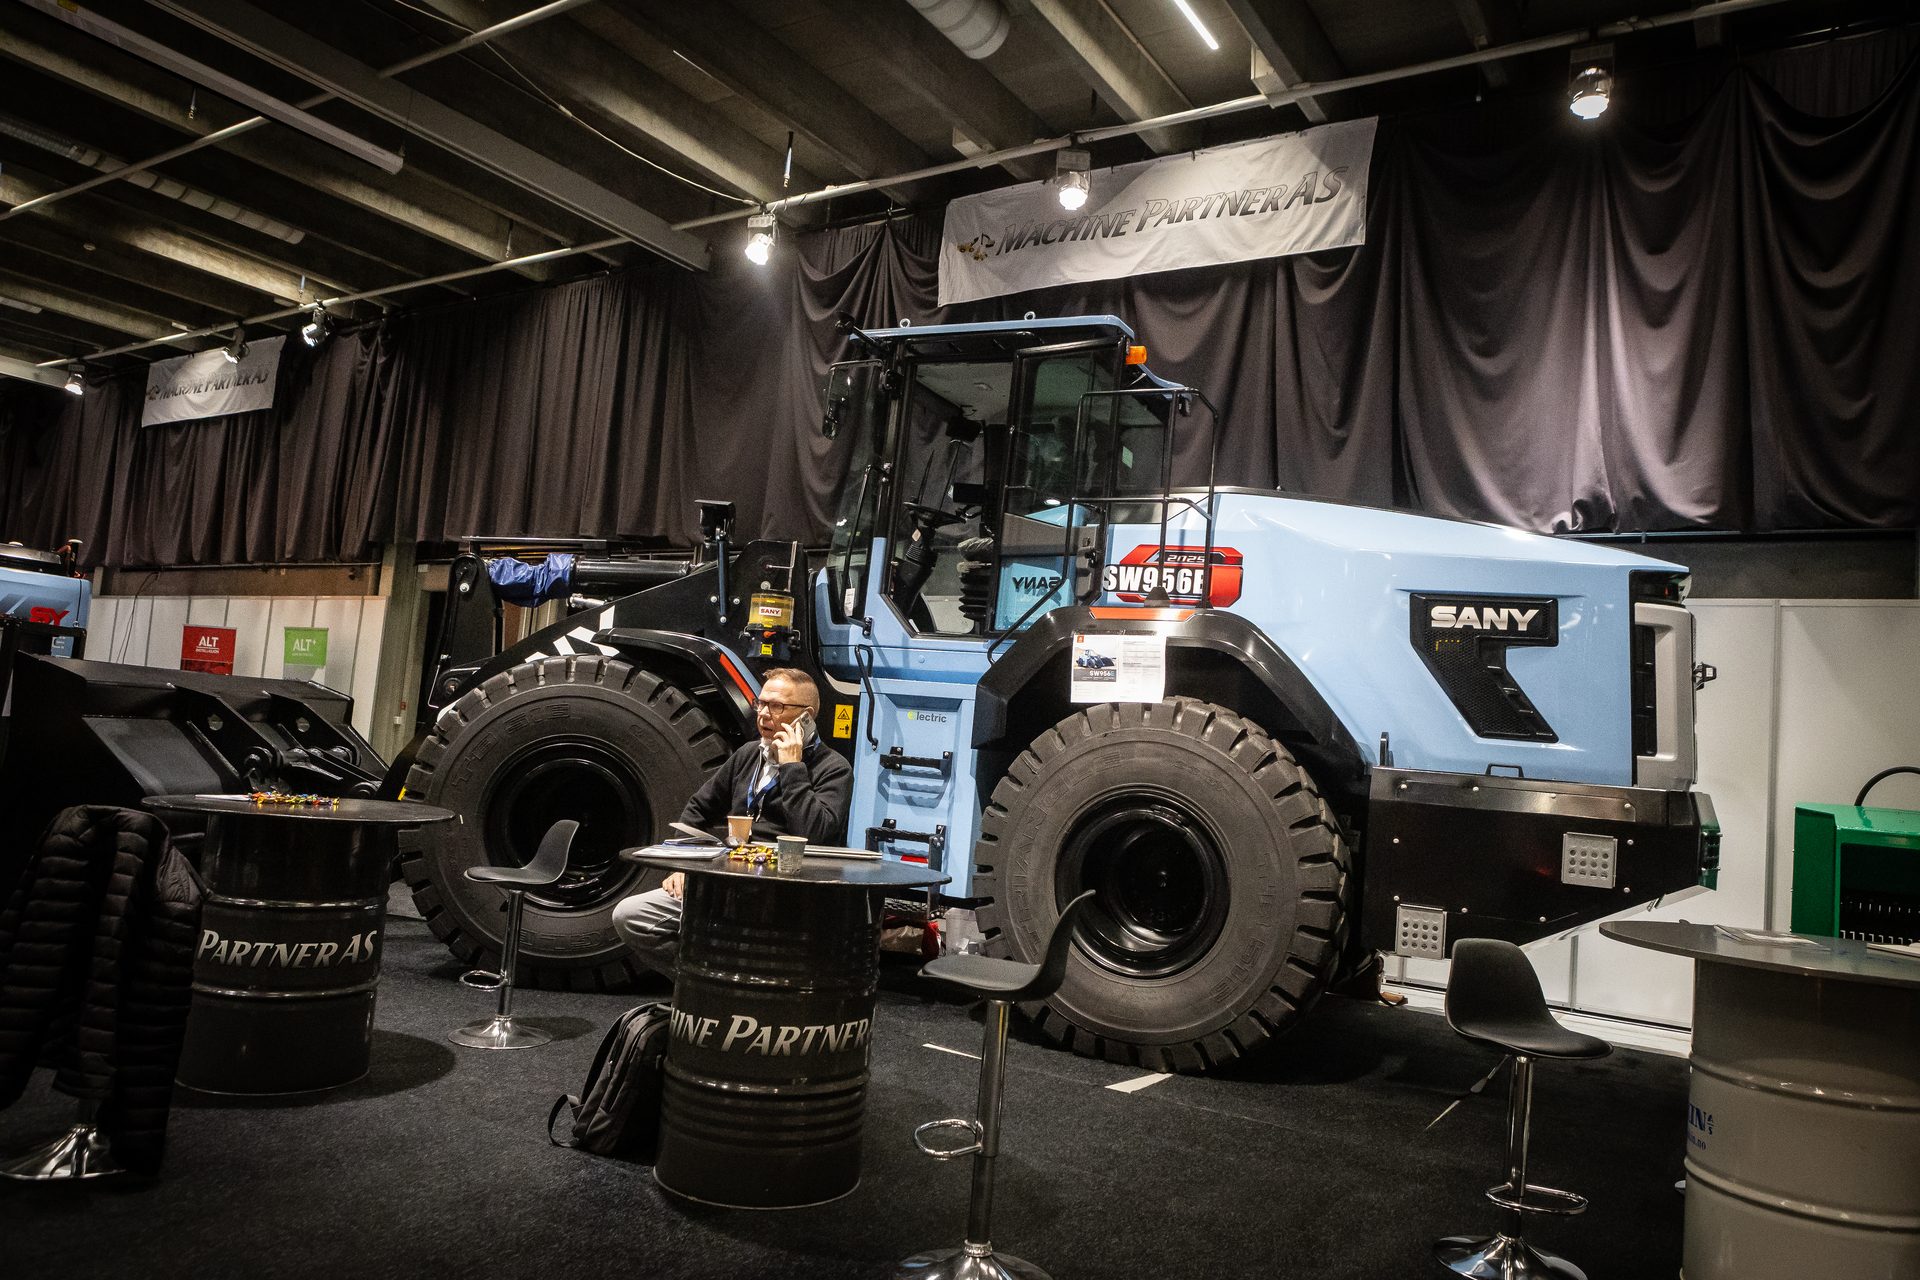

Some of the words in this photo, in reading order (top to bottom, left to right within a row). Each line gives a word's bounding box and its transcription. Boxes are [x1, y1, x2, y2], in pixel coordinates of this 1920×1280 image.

[996, 209, 1136, 256] MACHINE
[1135, 185, 1287, 233] PARTNER
[1284, 166, 1348, 209] AS
[30, 606, 70, 626] SY
[1430, 605, 1539, 631] SANY
[198, 636, 219, 647] ALT
[197, 929, 339, 969] PARTNER
[337, 929, 378, 966] AS
[720, 1014, 870, 1057] PARTNER
